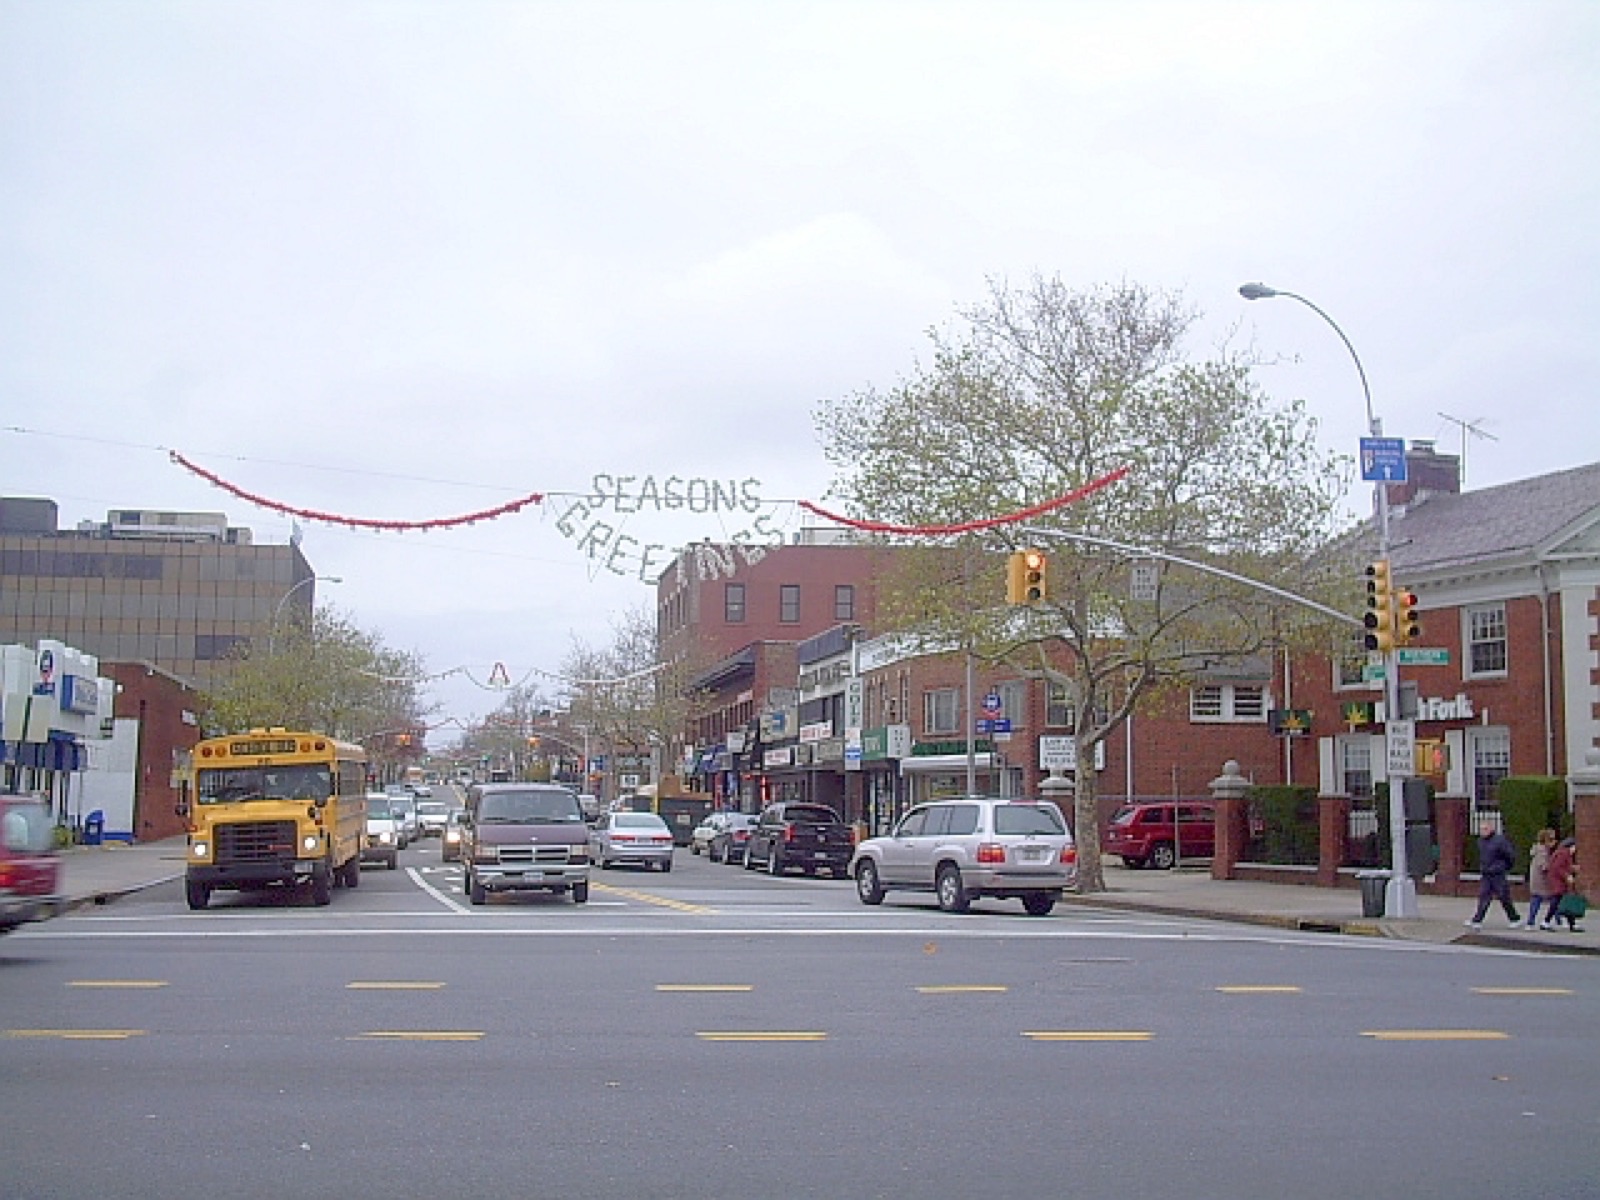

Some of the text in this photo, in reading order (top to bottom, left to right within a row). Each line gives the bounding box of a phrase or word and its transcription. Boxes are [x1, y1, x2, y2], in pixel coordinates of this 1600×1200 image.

[587, 473, 761, 513] SEASONS
[555, 500, 785, 585] GREETINGS
[1428, 692, 1474, 720] Fork
